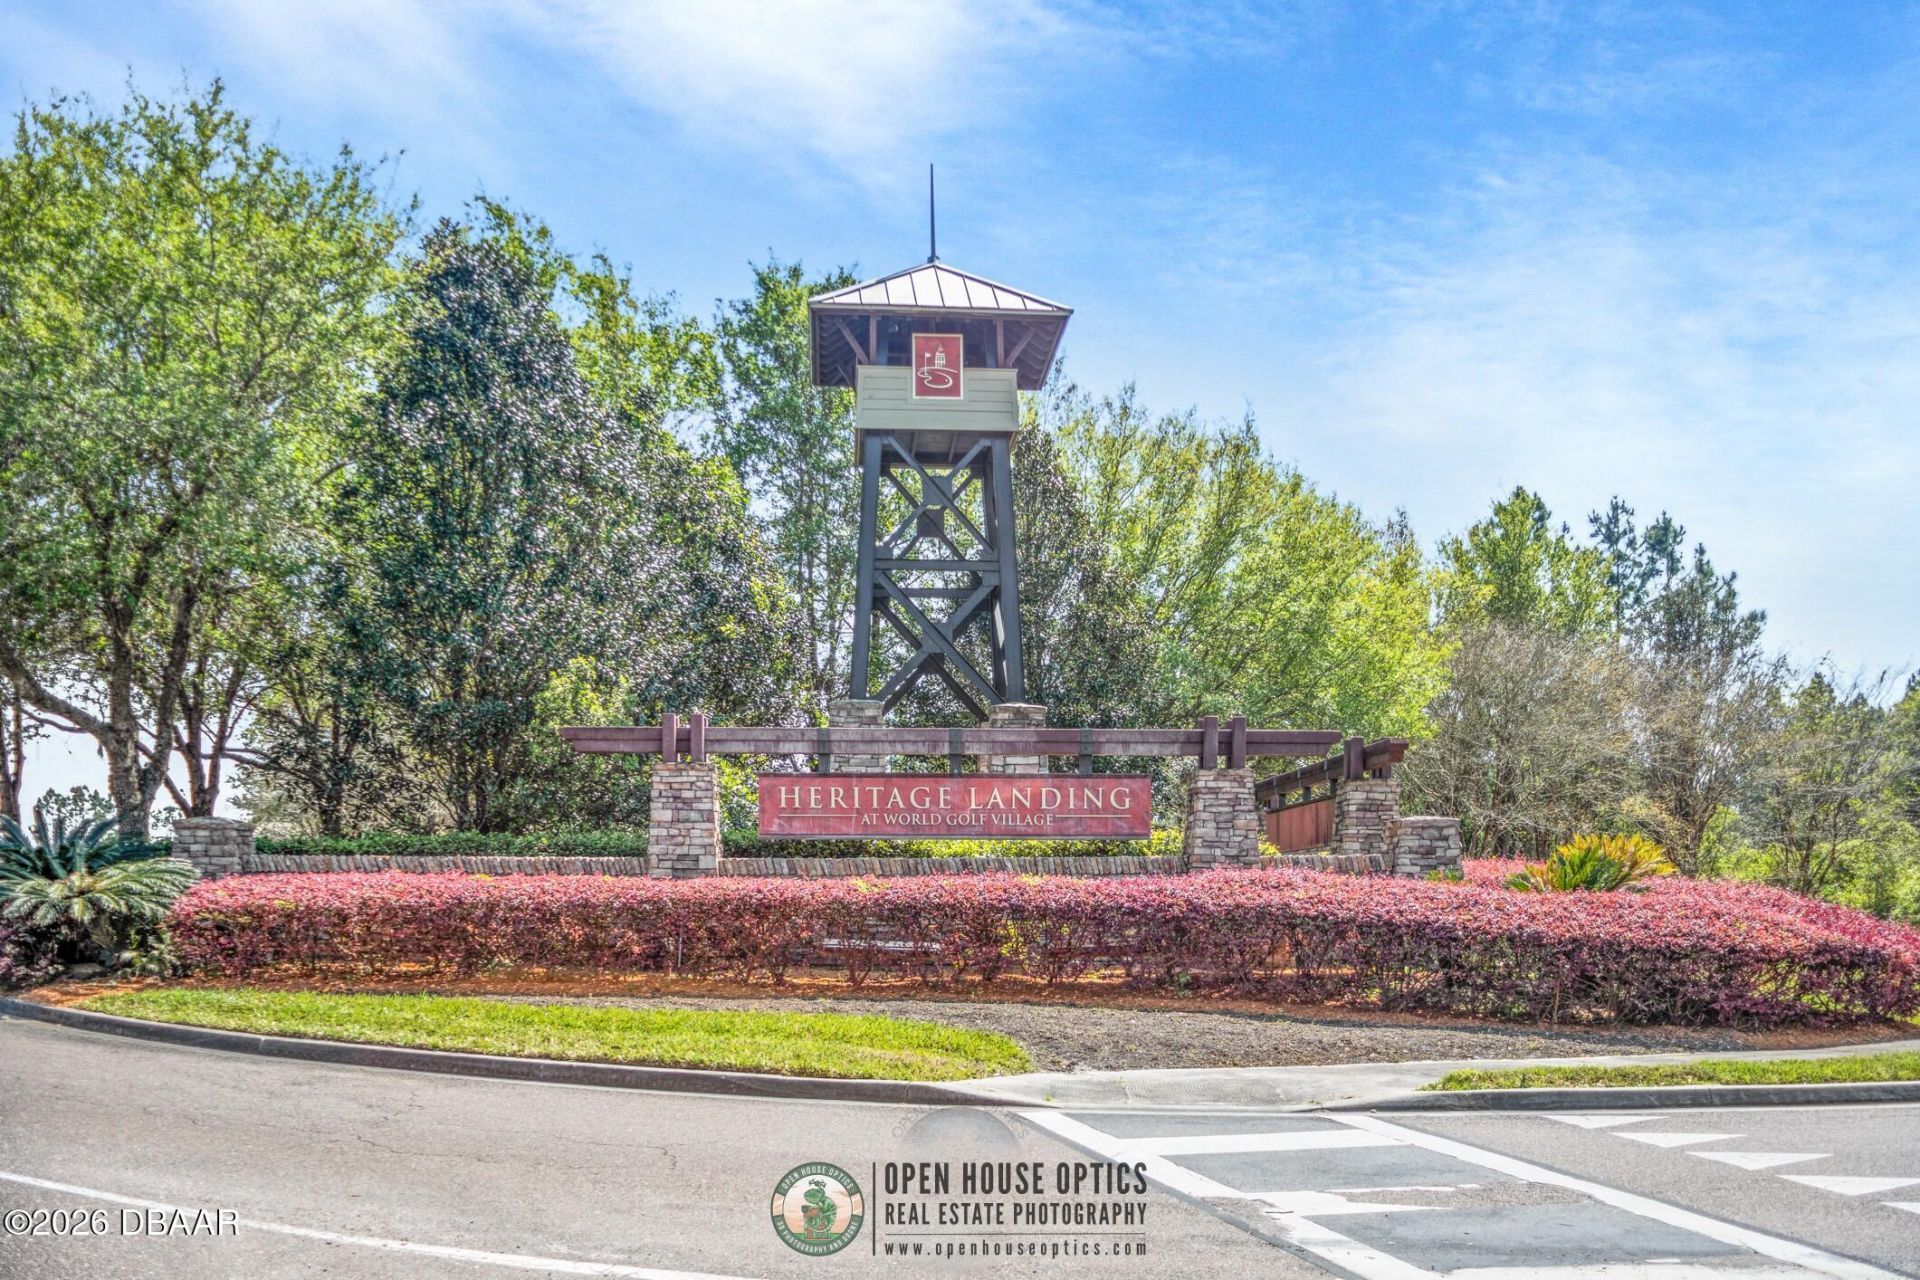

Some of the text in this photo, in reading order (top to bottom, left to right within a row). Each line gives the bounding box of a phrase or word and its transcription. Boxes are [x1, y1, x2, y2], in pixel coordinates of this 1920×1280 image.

[779, 786, 1131, 811] HERITAGE LANDING
[861, 814, 1054, 826] AT WORLD GOLF VILLAGE
